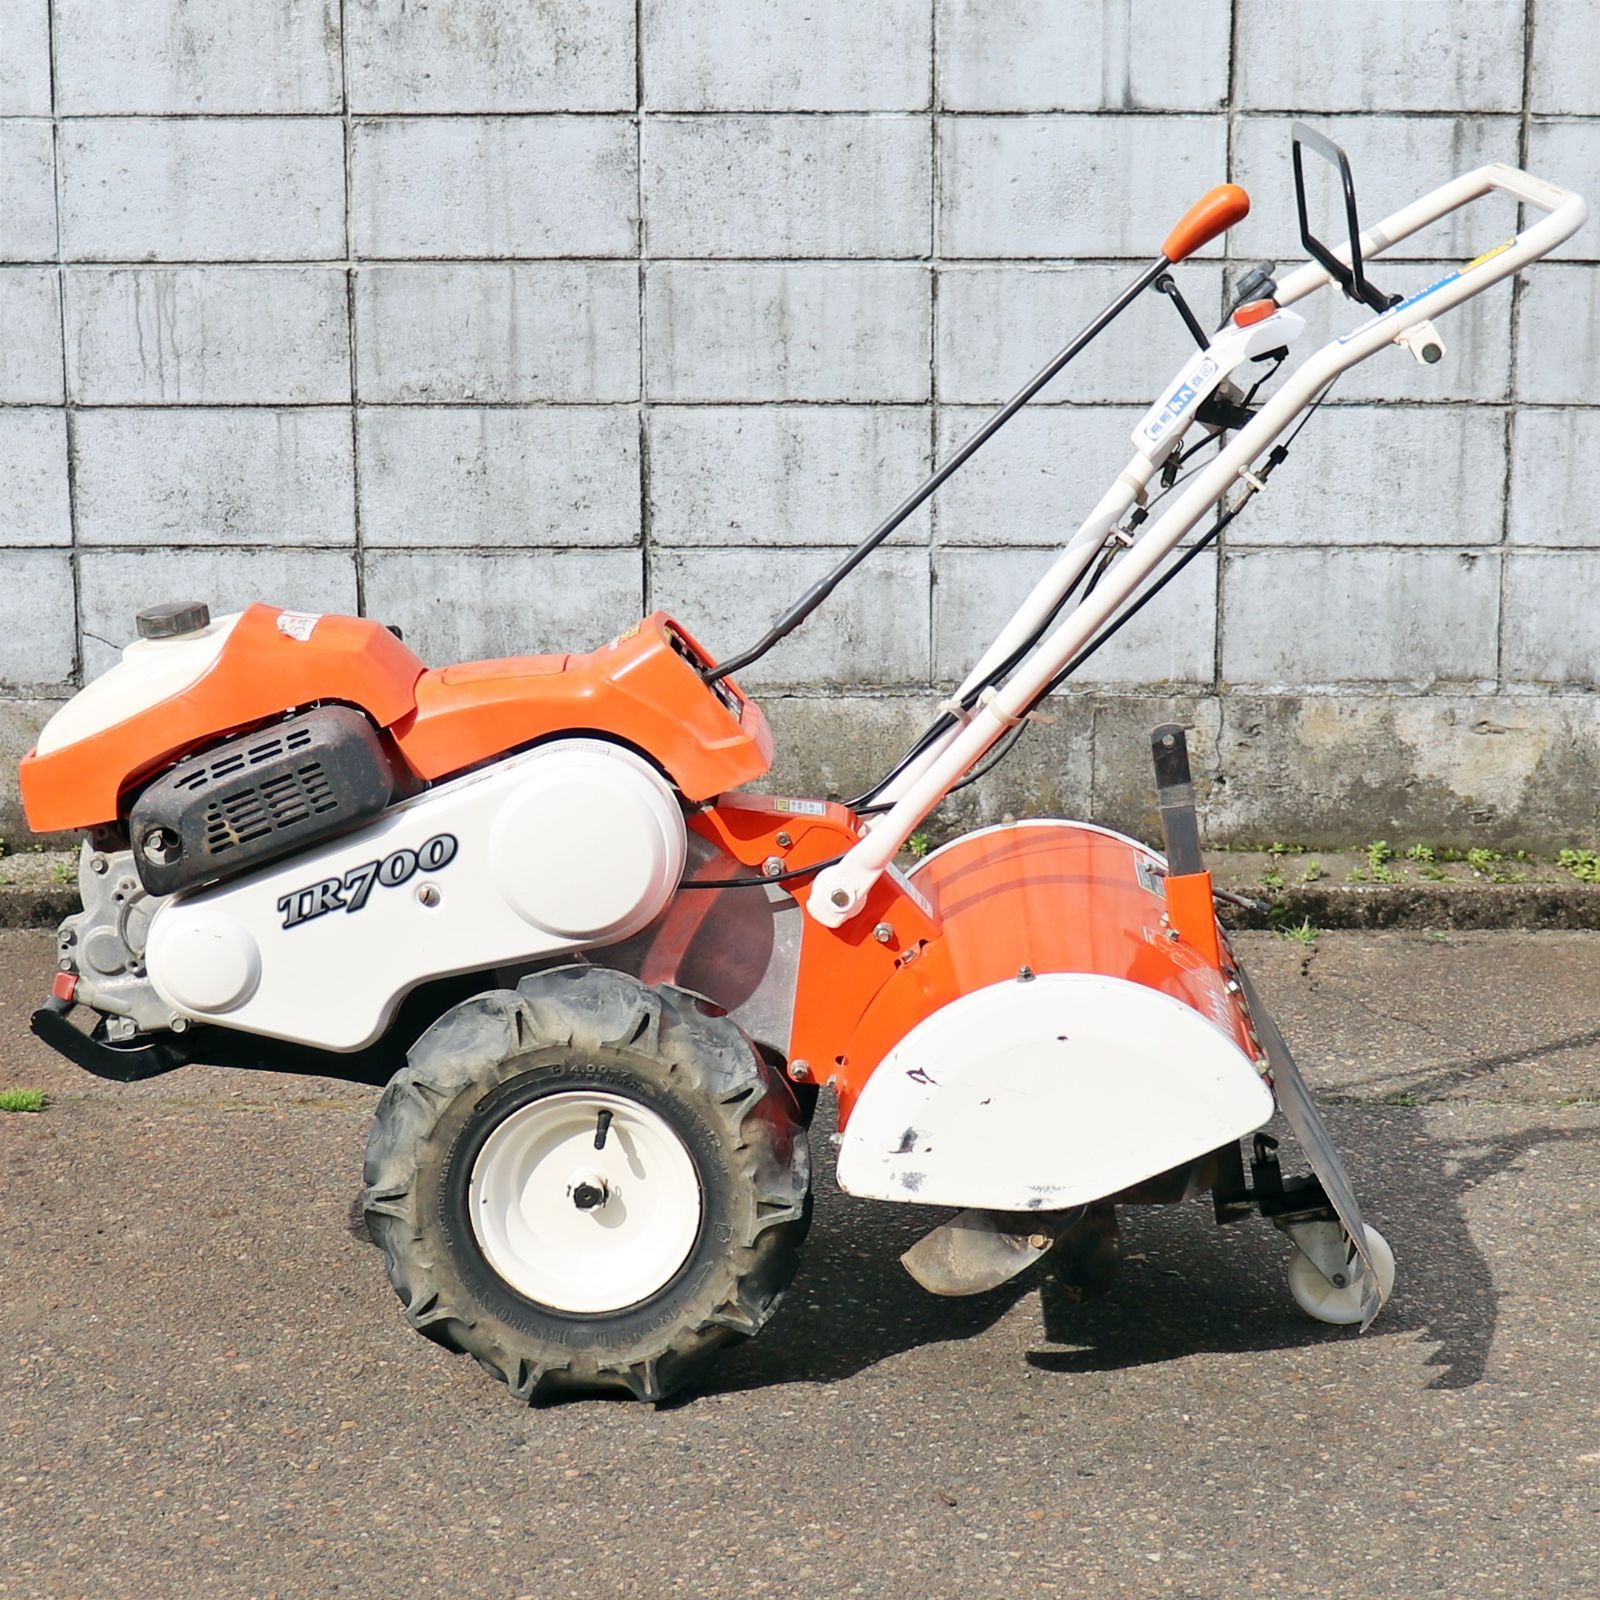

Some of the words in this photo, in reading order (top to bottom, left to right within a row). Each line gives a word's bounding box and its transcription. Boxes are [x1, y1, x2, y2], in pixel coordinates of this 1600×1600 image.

[1168, 385, 1194, 413] デフ
[277, 833, 459, 929] TR700
[568, 1062, 633, 1078] 4.00-7
